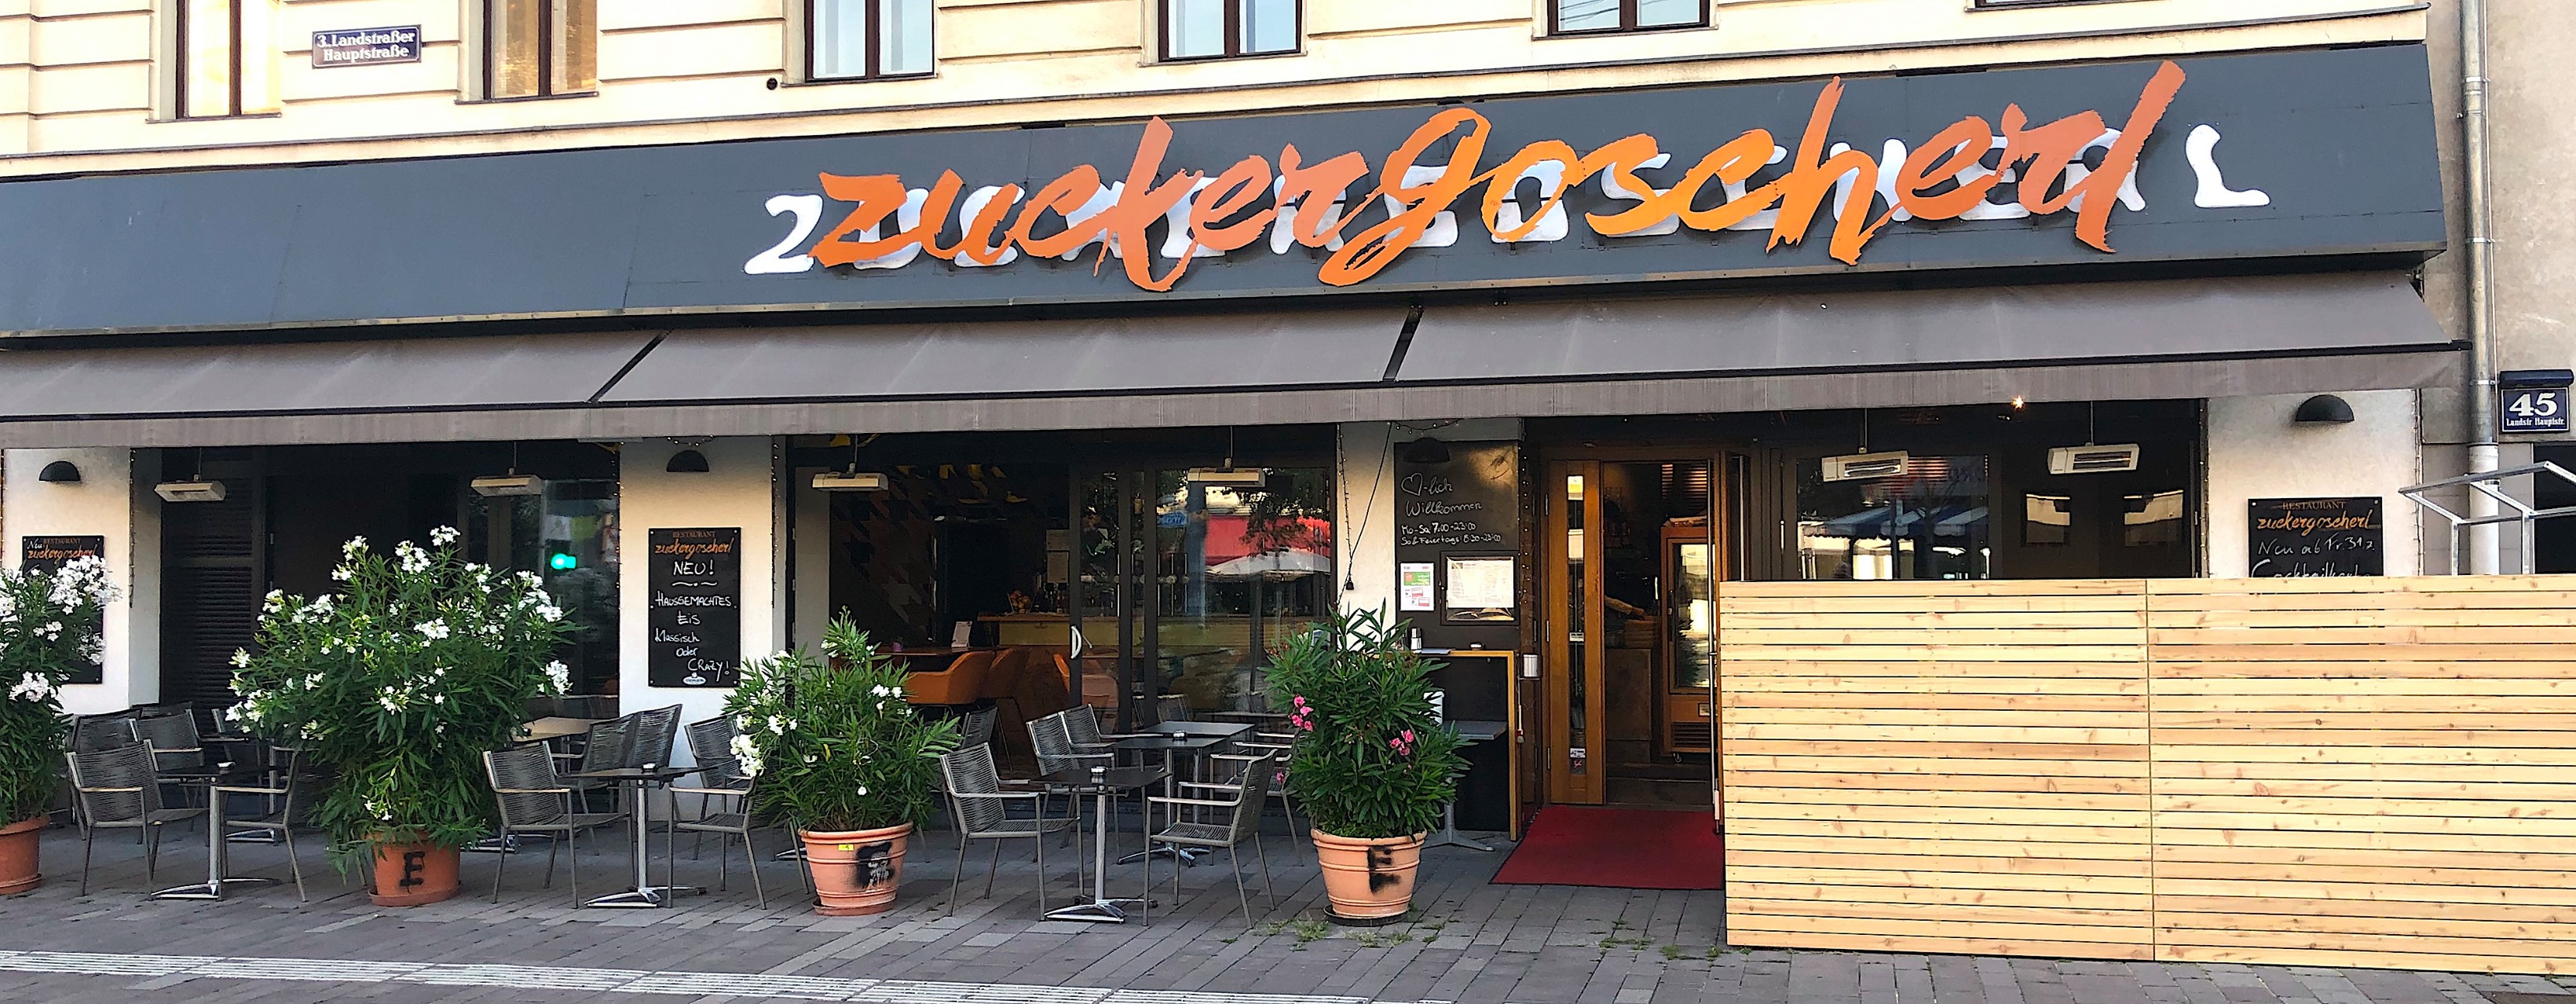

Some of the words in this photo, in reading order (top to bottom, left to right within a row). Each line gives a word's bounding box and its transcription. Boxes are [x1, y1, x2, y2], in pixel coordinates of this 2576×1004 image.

[324, 44, 409, 62] Hauptstraße
[807, 60, 2186, 291] zuckergoscherl
[2508, 393, 2557, 416] 45
[1406, 500, 1482, 516] Willkommen
[2282, 501, 2346, 510] RESTAURANT
[2257, 509, 2373, 536] zuckergoscherl
[654, 537, 734, 559] zuckergoscherl
[2258, 538, 2294, 555] Neu
[2301, 538, 2321, 555] ab
